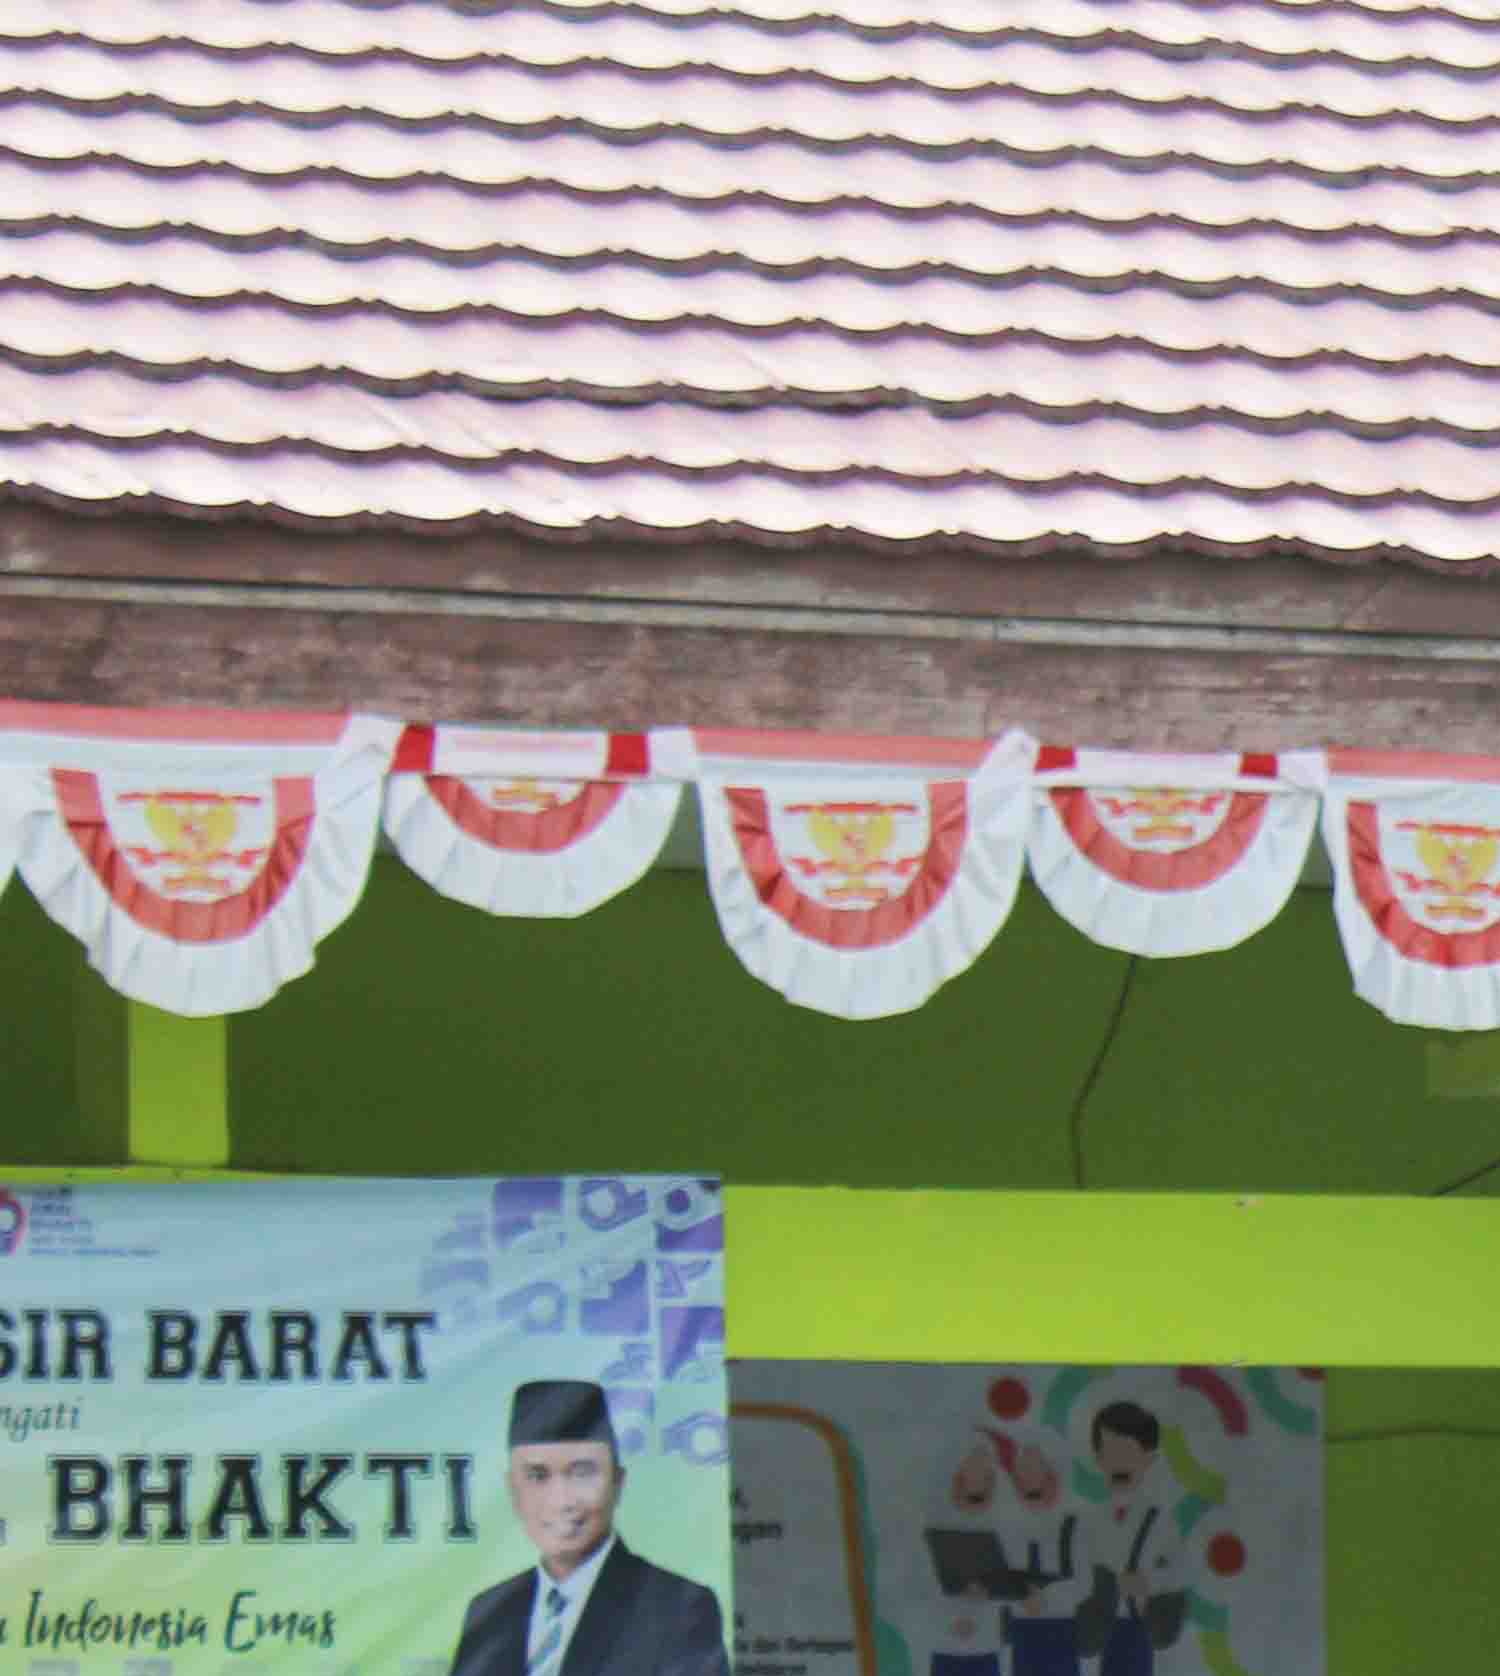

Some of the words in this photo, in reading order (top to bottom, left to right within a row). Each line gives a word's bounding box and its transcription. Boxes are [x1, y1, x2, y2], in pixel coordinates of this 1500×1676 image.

[146, 1309, 437, 1384] BARAT
[47, 1453, 478, 1546] BHAKTI
[24, 1588, 208, 1650] Indonesia
[225, 1589, 337, 1653] Emas
